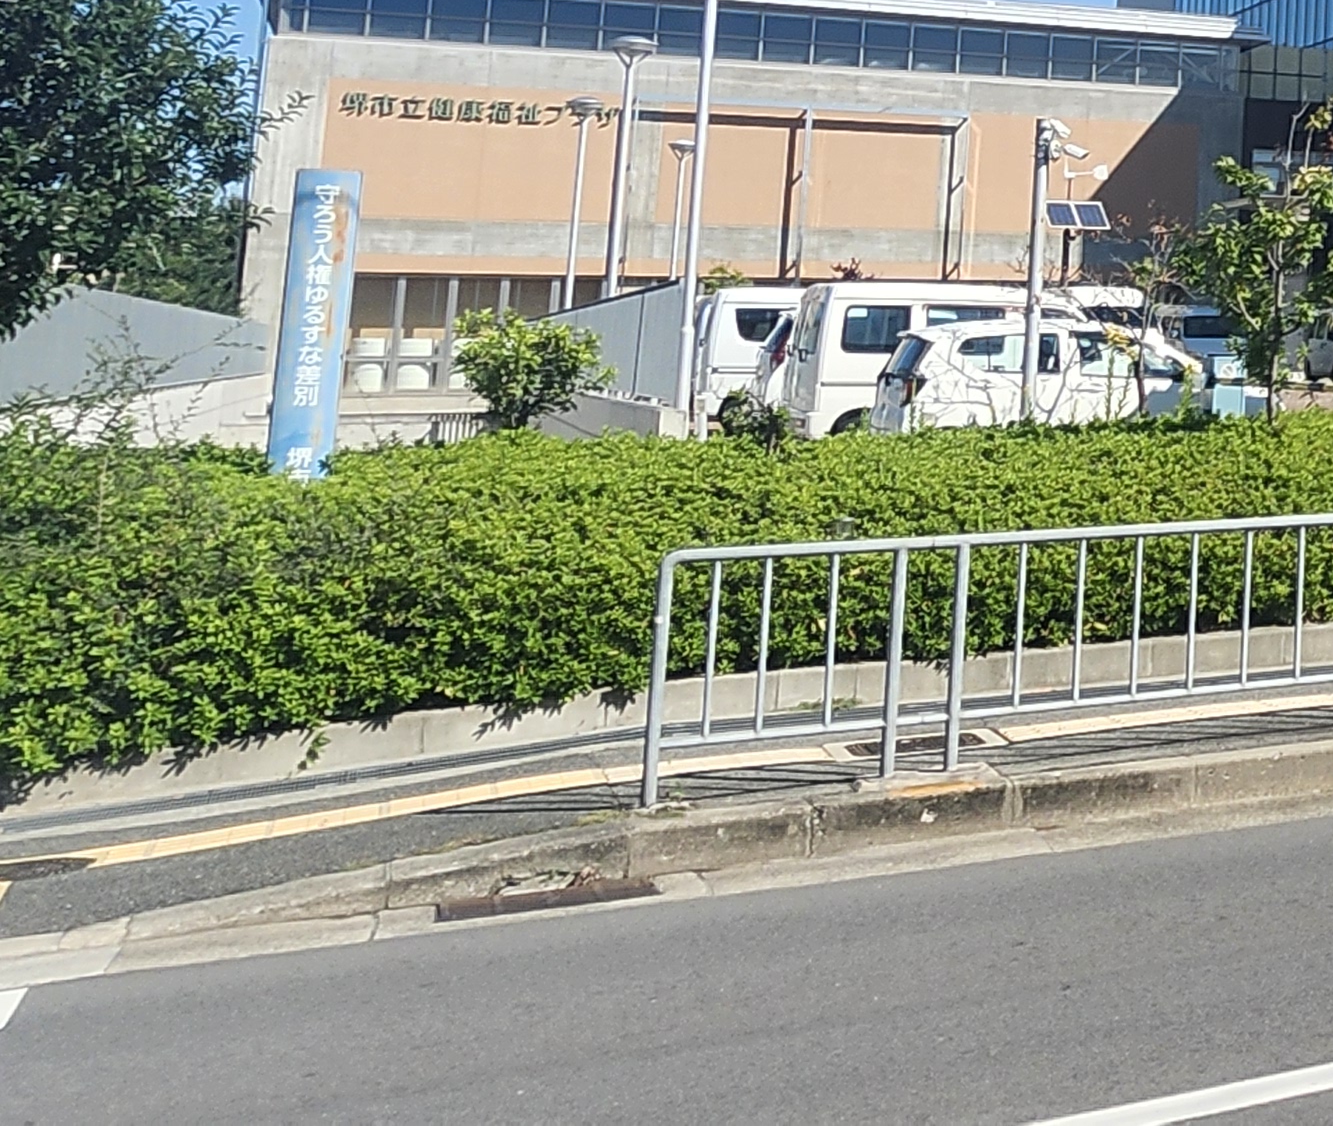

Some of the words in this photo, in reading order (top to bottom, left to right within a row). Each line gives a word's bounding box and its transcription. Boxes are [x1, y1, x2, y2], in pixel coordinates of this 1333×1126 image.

[292, 184, 341, 408] 守ろう人権ゆるすな差別
